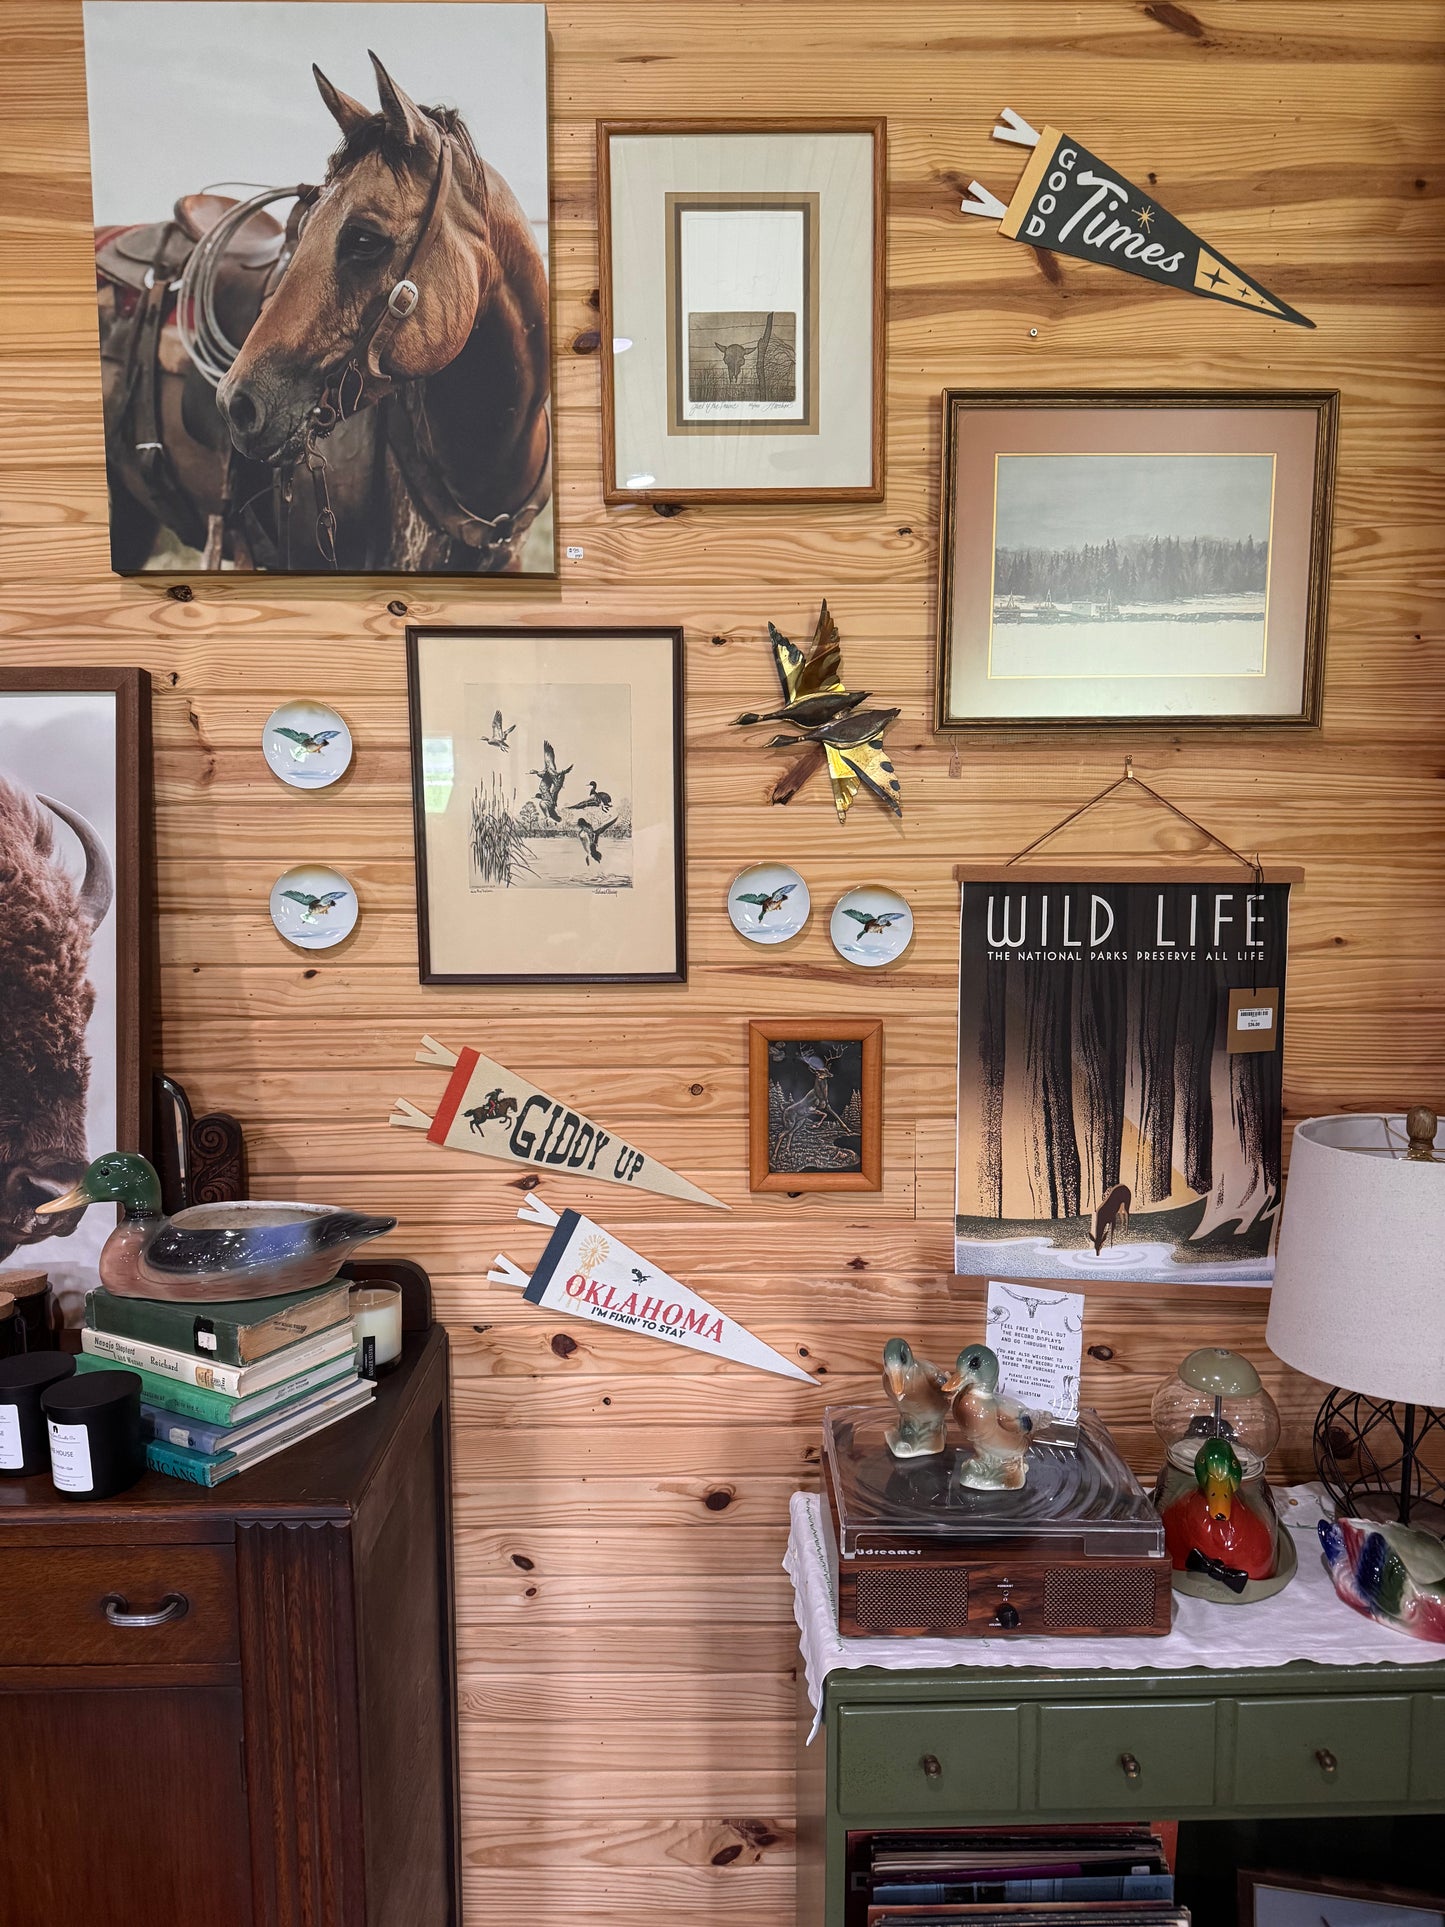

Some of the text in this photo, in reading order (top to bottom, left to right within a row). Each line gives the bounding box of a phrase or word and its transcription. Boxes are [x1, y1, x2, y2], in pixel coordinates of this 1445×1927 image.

[1025, 148, 1078, 237] GOOD
[1058, 170, 1185, 272] Times
[987, 894, 1264, 947] WILD LIFE
[988, 951, 1265, 961] THE NATIONAL PARKS PRESERVE ALL LIFE
[509, 1094, 645, 1181] GIDDY UP
[566, 1274, 725, 1343] OKLAHOMA
[591, 1306, 686, 1339] I'M FIXIN' TO STAY
[1014, 1332, 1034, 1340] RECORD
[1037, 1335, 1062, 1344] DISPLAYS
[1041, 1328, 1054, 1336] PULL
[94, 1337, 114, 1350] Navajo
[1024, 1340, 1046, 1348] THROUGH
[1032, 1352, 1054, 1361] WELCOME
[150, 1356, 178, 1372] Reichard
[1033, 1365, 1056, 1374] PURCHASE
[1036, 1360, 1054, 1368] RECORD
[1055, 1362, 1073, 1370] PLAYER
